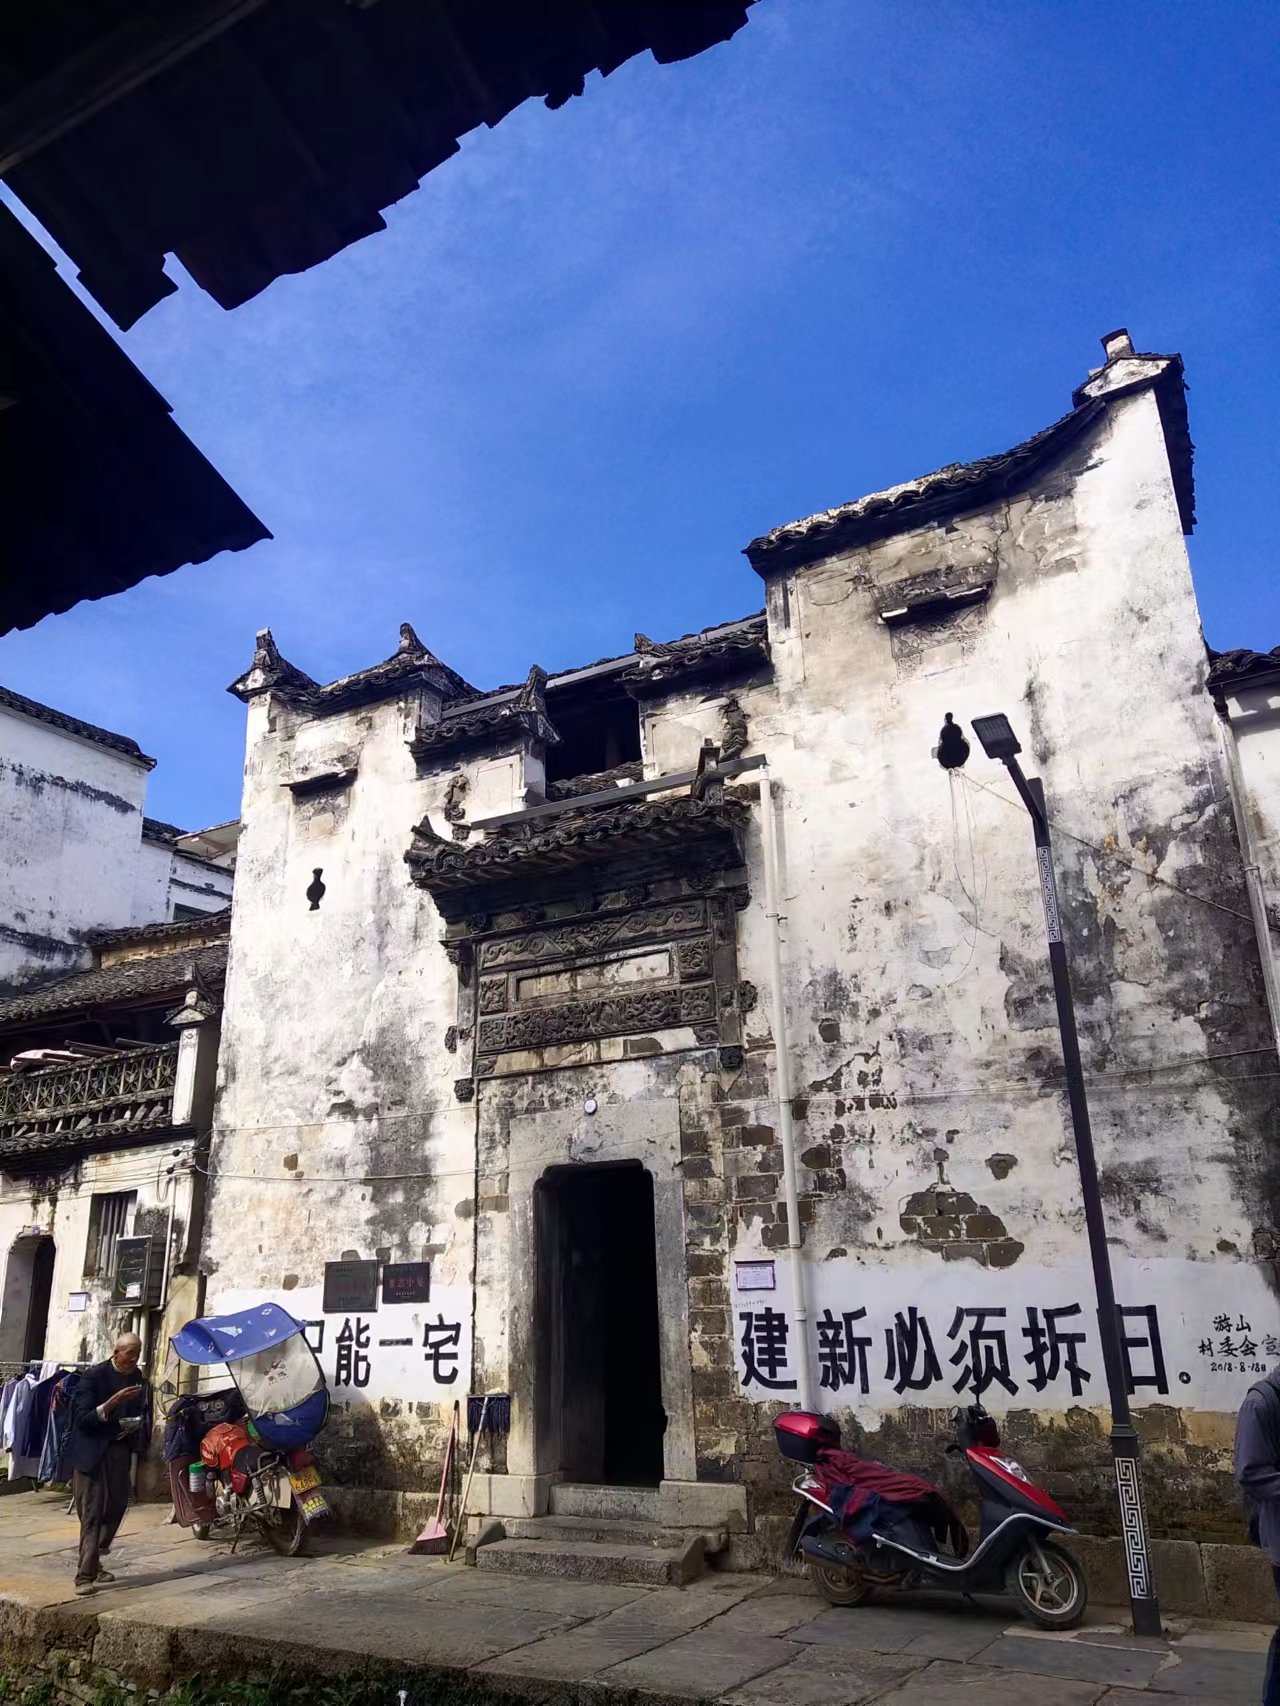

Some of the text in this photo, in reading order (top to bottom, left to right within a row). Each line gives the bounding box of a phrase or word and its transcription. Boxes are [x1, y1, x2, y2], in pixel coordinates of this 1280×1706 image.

[1212, 1313, 1251, 1333] 游山
[1198, 1333, 1280, 1358] 村委会宣
